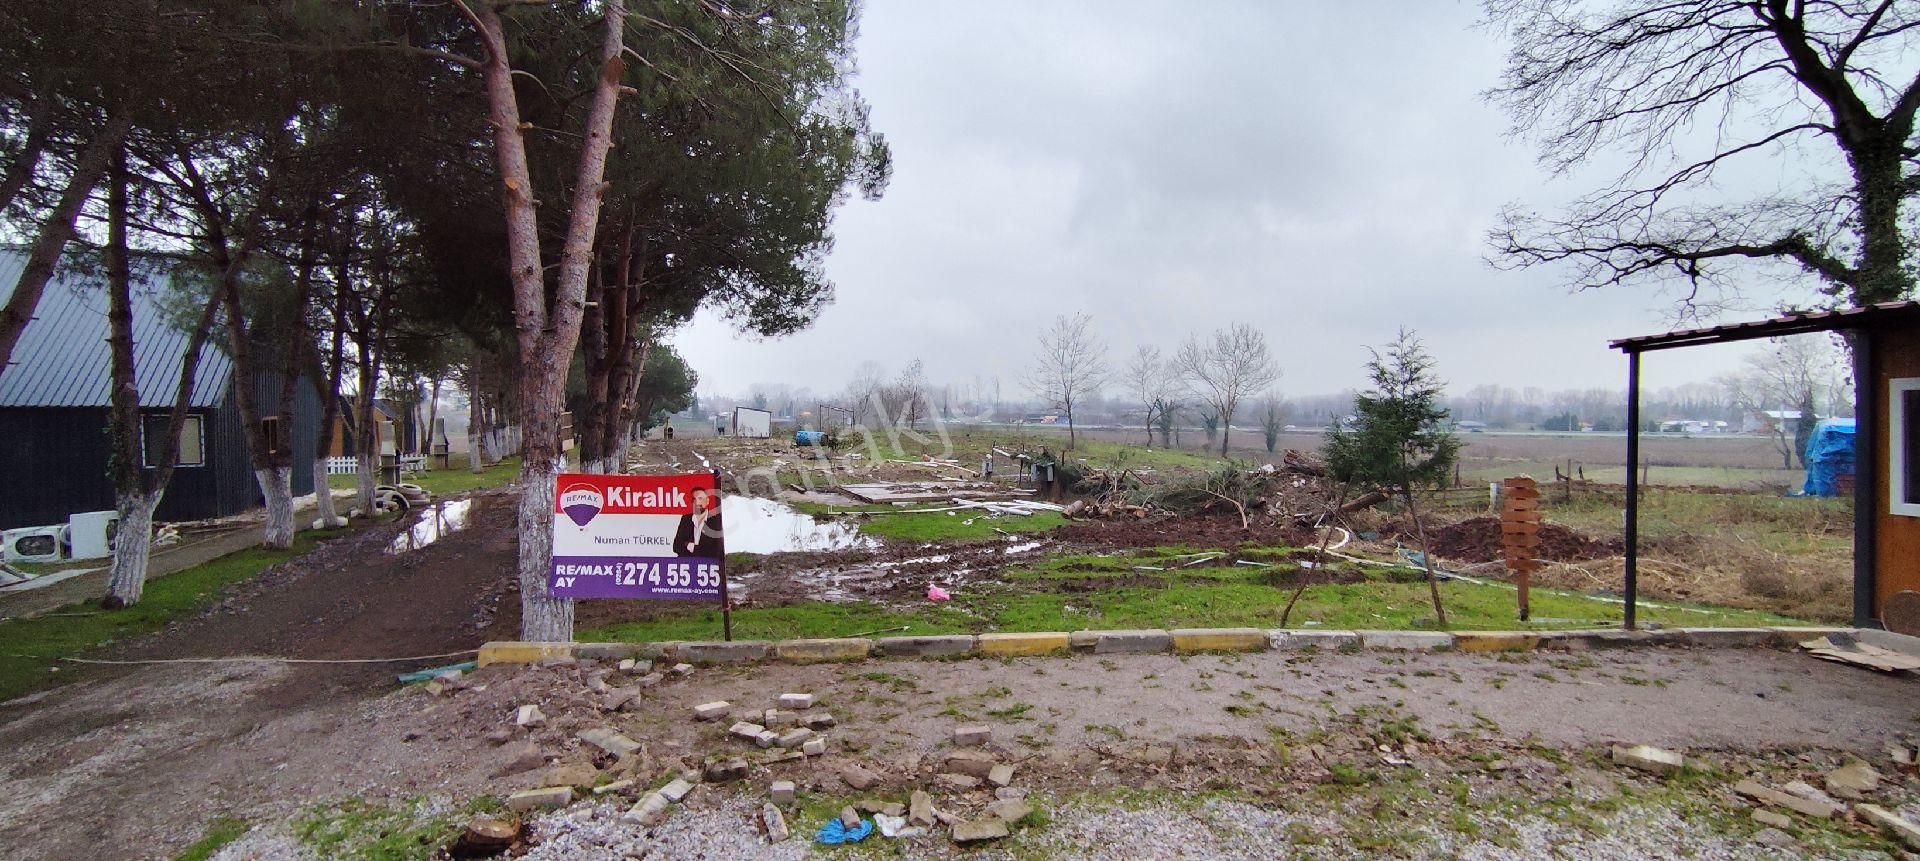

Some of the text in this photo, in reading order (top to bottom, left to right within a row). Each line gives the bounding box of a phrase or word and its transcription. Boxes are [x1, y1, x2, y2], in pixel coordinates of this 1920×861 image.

[566, 494, 599, 503] RE/MAX
[607, 486, 688, 508] Kiralık
[594, 533, 671, 546] Numan TÜRKEL
[555, 565, 614, 576] RE/MAX
[623, 562, 661, 586] 274
[666, 563, 690, 587] 55
[696, 564, 721, 587] 55
[554, 577, 577, 588] AY
